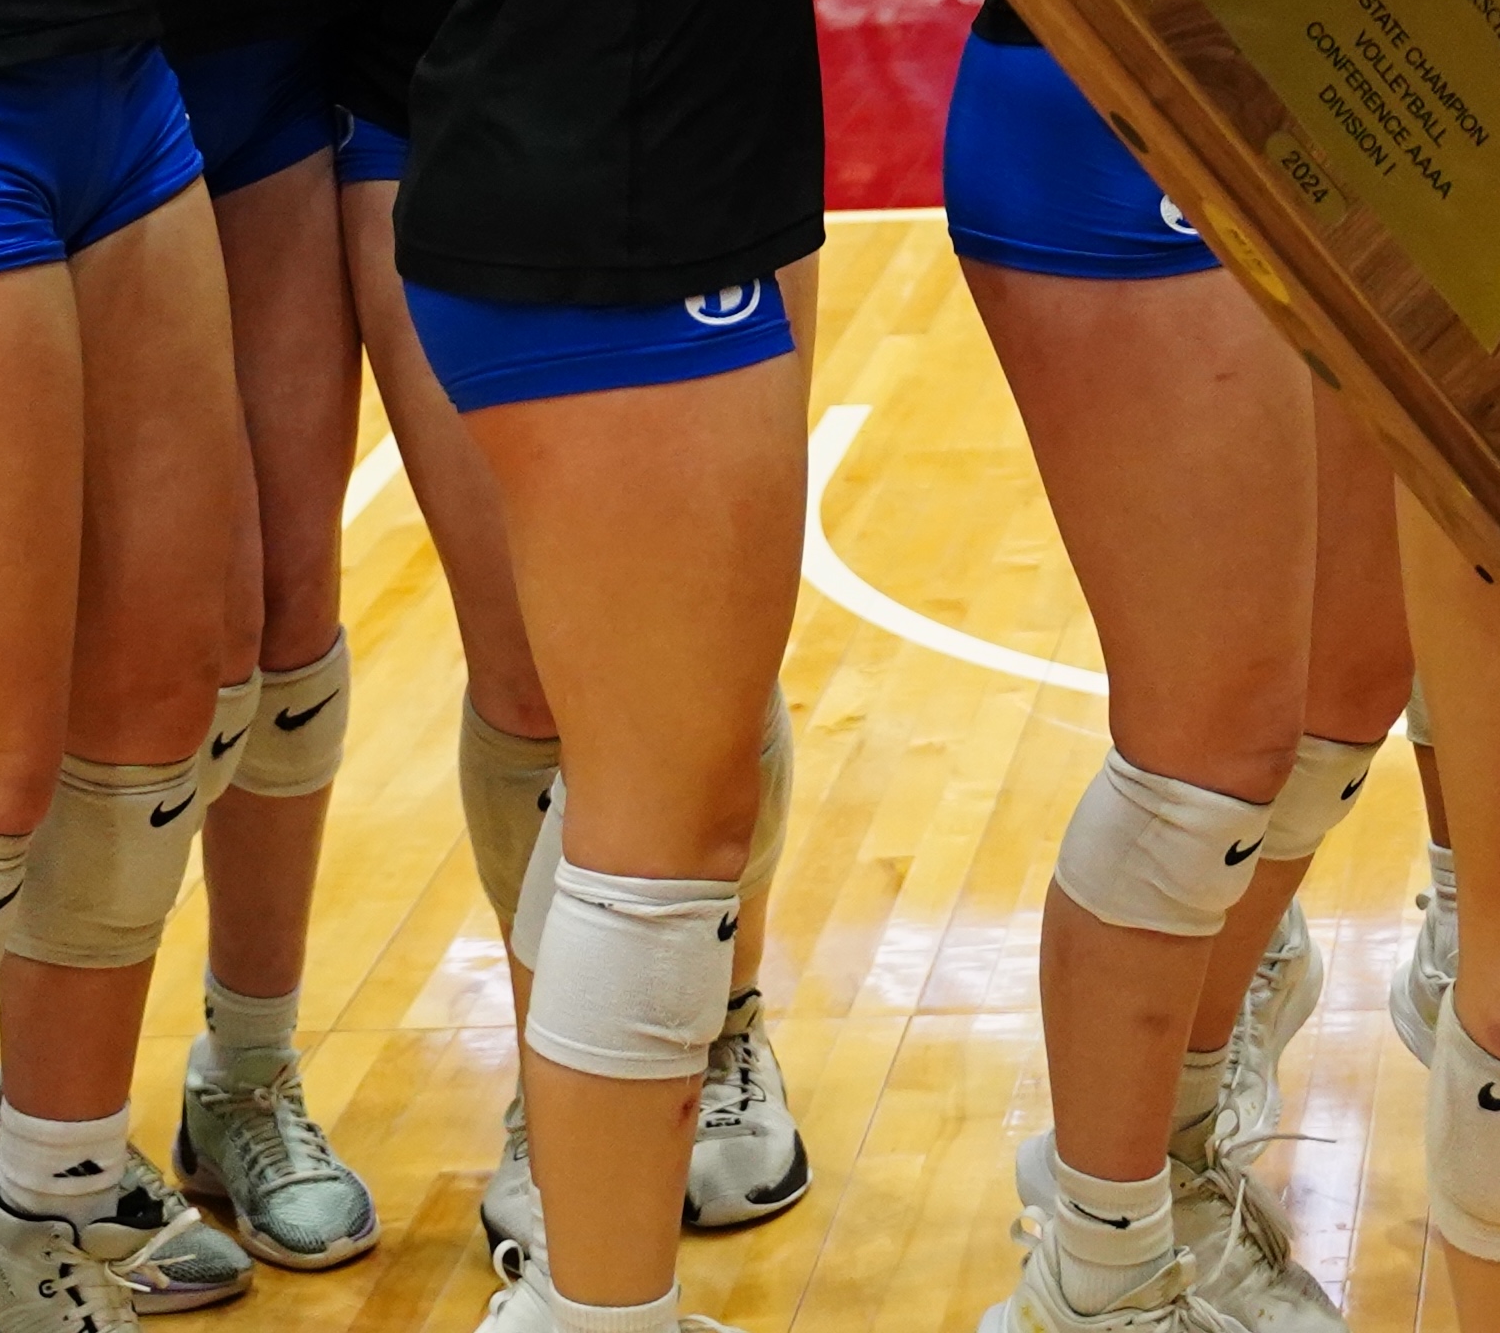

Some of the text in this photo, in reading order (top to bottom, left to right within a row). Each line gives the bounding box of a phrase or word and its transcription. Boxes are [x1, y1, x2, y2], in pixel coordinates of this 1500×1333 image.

[1305, 20, 1453, 200] CONFERENCE AAAA
[1318, 84, 1397, 177] DIVISION I
[1353, 28, 1450, 150] VOLLEYBALL
[1404, 45, 1490, 148] CHAMPION
[1280, 149, 1330, 205] 2024
